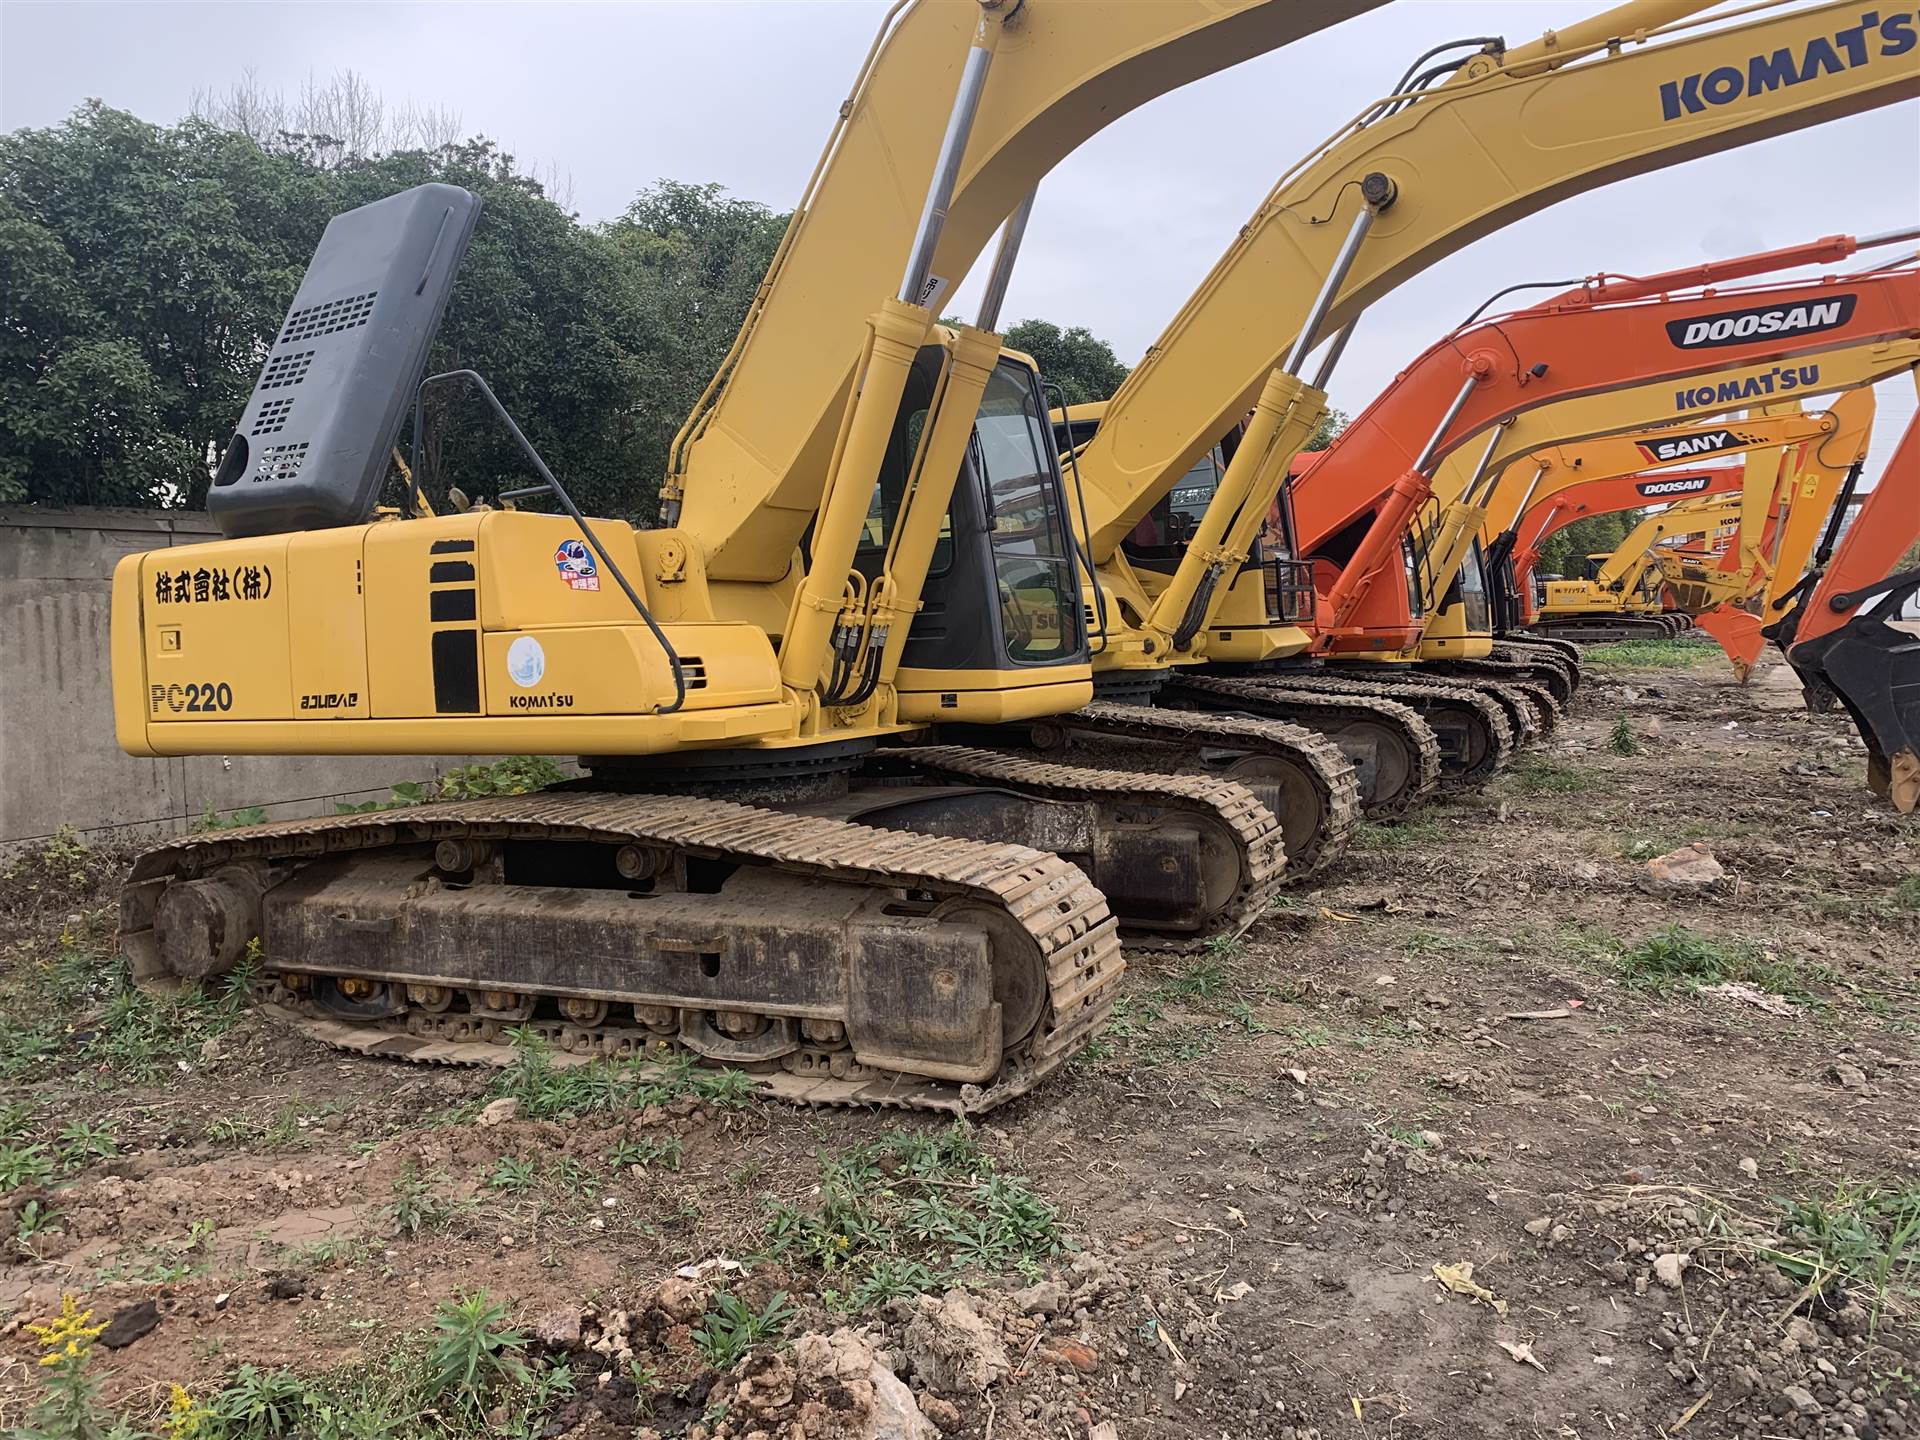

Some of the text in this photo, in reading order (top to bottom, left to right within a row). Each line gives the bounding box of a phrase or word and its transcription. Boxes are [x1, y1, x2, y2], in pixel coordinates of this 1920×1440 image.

[1659, 10, 1920, 121] KOMATS
[1683, 302, 1841, 345] DOOSAN
[1676, 365, 1819, 411] KOMATSU
[1658, 433, 1727, 460] SANY
[1644, 479, 1705, 495] DOOSAN
[151, 682, 233, 713] PC220
[510, 692, 574, 708] KOMATSU
